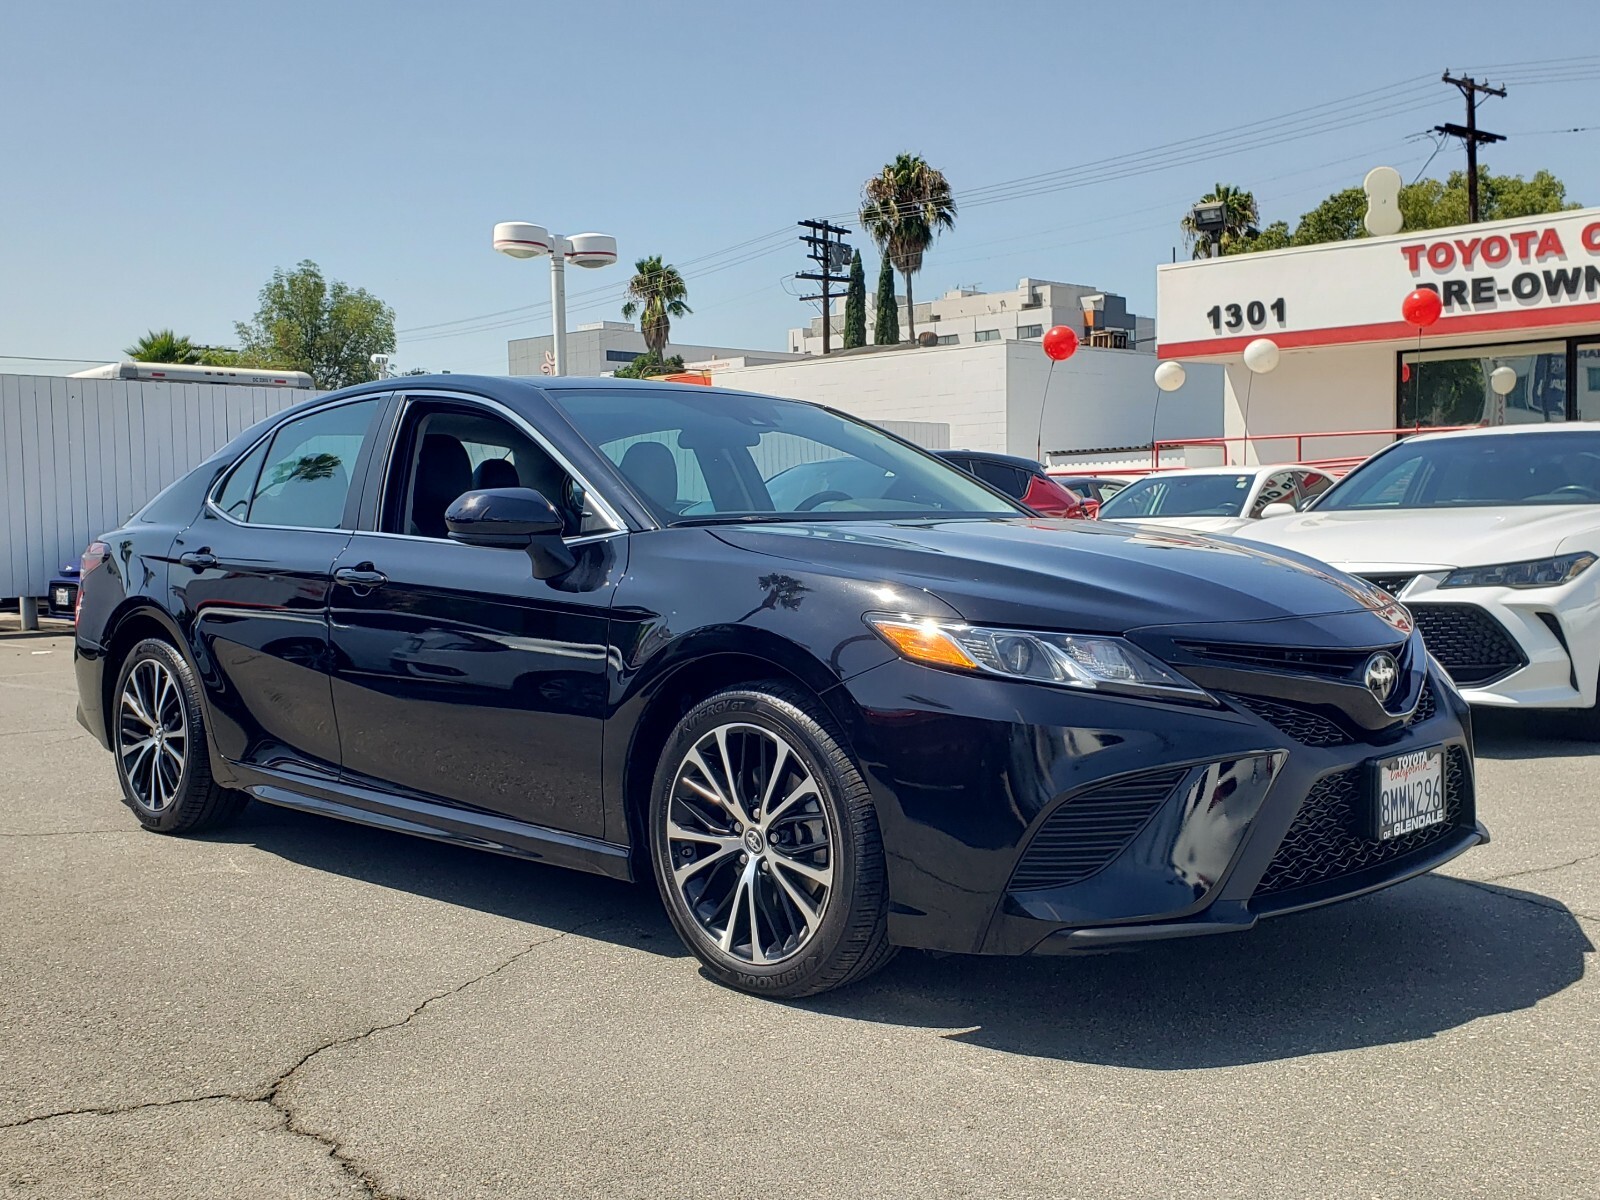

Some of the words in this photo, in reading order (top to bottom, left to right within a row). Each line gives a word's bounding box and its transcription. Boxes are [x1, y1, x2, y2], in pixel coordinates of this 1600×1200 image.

[1400, 228, 1566, 272] TOYOTA
[1206, 297, 1285, 330] 1301
[1397, 751, 1428, 770] TOYOTA
[1381, 775, 1440, 826] 8MMW296
[1383, 830, 1392, 840] OF
[1393, 810, 1444, 836] GLENDALE
